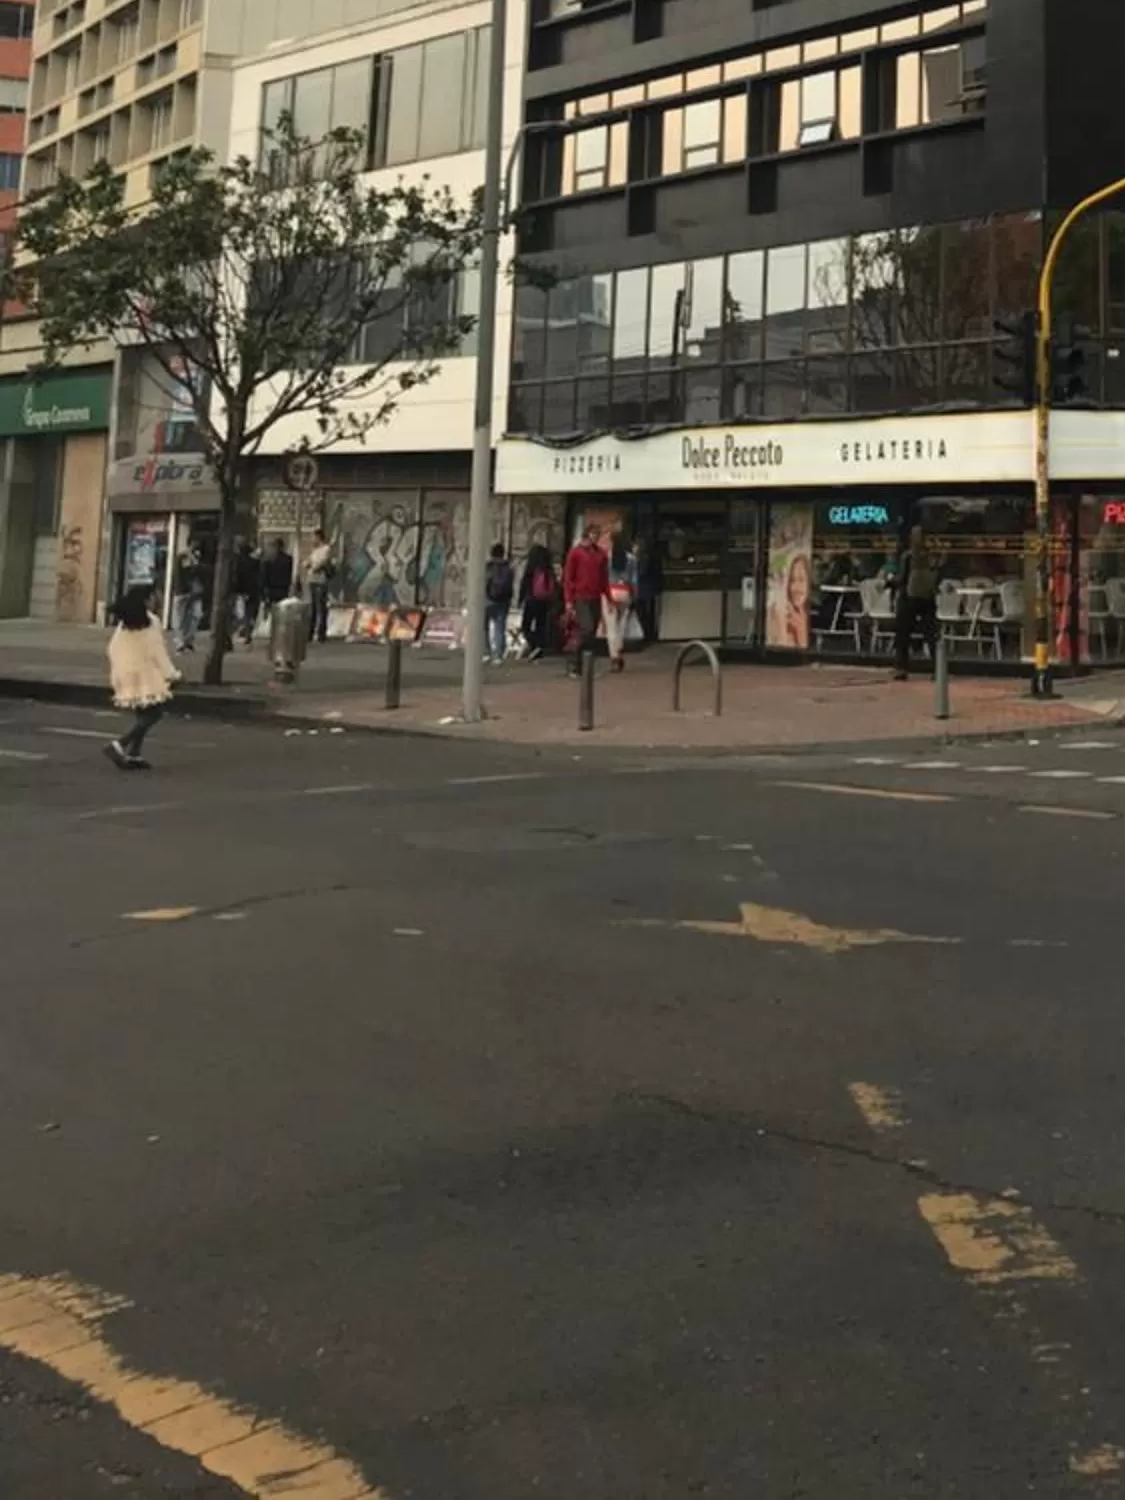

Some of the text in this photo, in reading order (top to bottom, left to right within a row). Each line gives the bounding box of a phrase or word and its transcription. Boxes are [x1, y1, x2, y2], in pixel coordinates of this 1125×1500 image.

[682, 434, 783, 469] Dolce Peccato
[841, 439, 947, 462] GELATERIA
[554, 454, 621, 473] PIZZERIA
